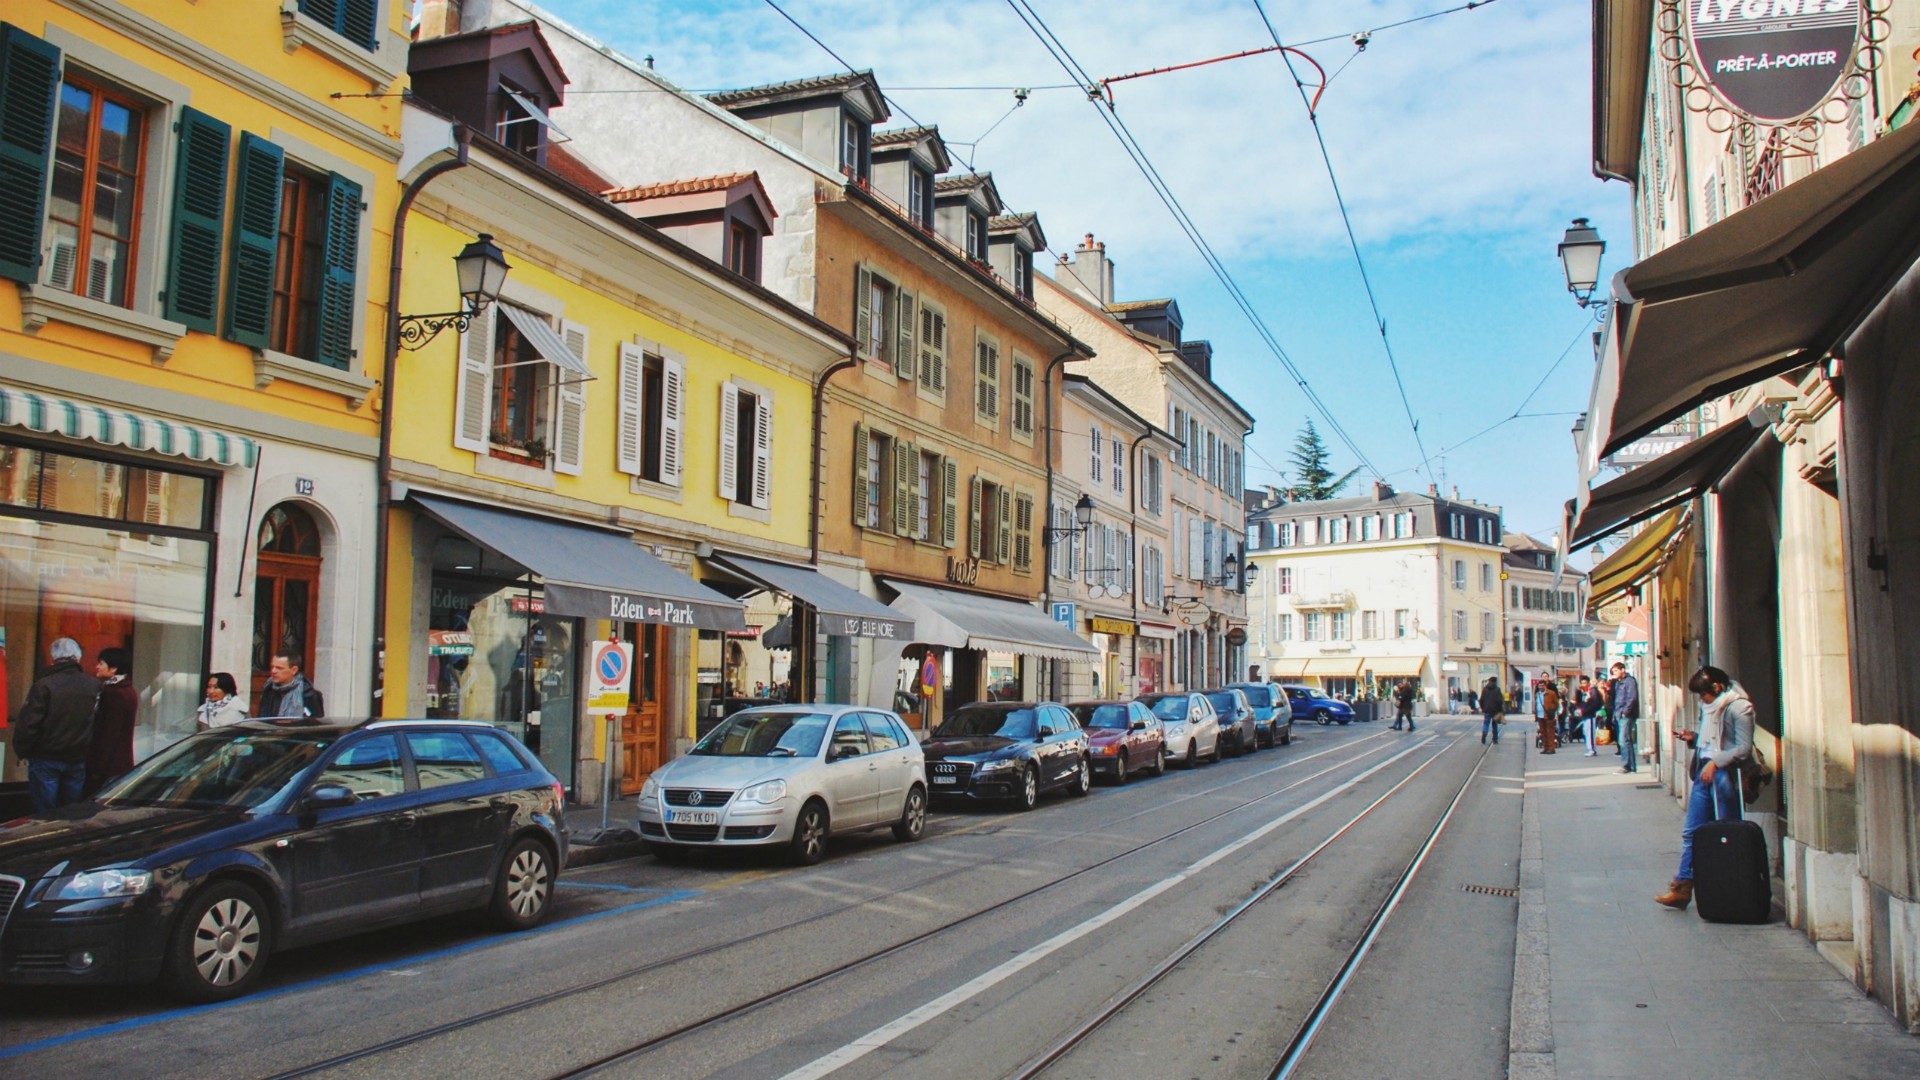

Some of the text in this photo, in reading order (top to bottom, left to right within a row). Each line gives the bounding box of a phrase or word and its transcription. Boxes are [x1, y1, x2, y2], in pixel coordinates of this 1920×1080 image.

[299, 480, 311, 494] 12
[610, 595, 695, 625] Eden Park
[1060, 605, 1069, 620] P
[694, 813, 703, 822] YK
